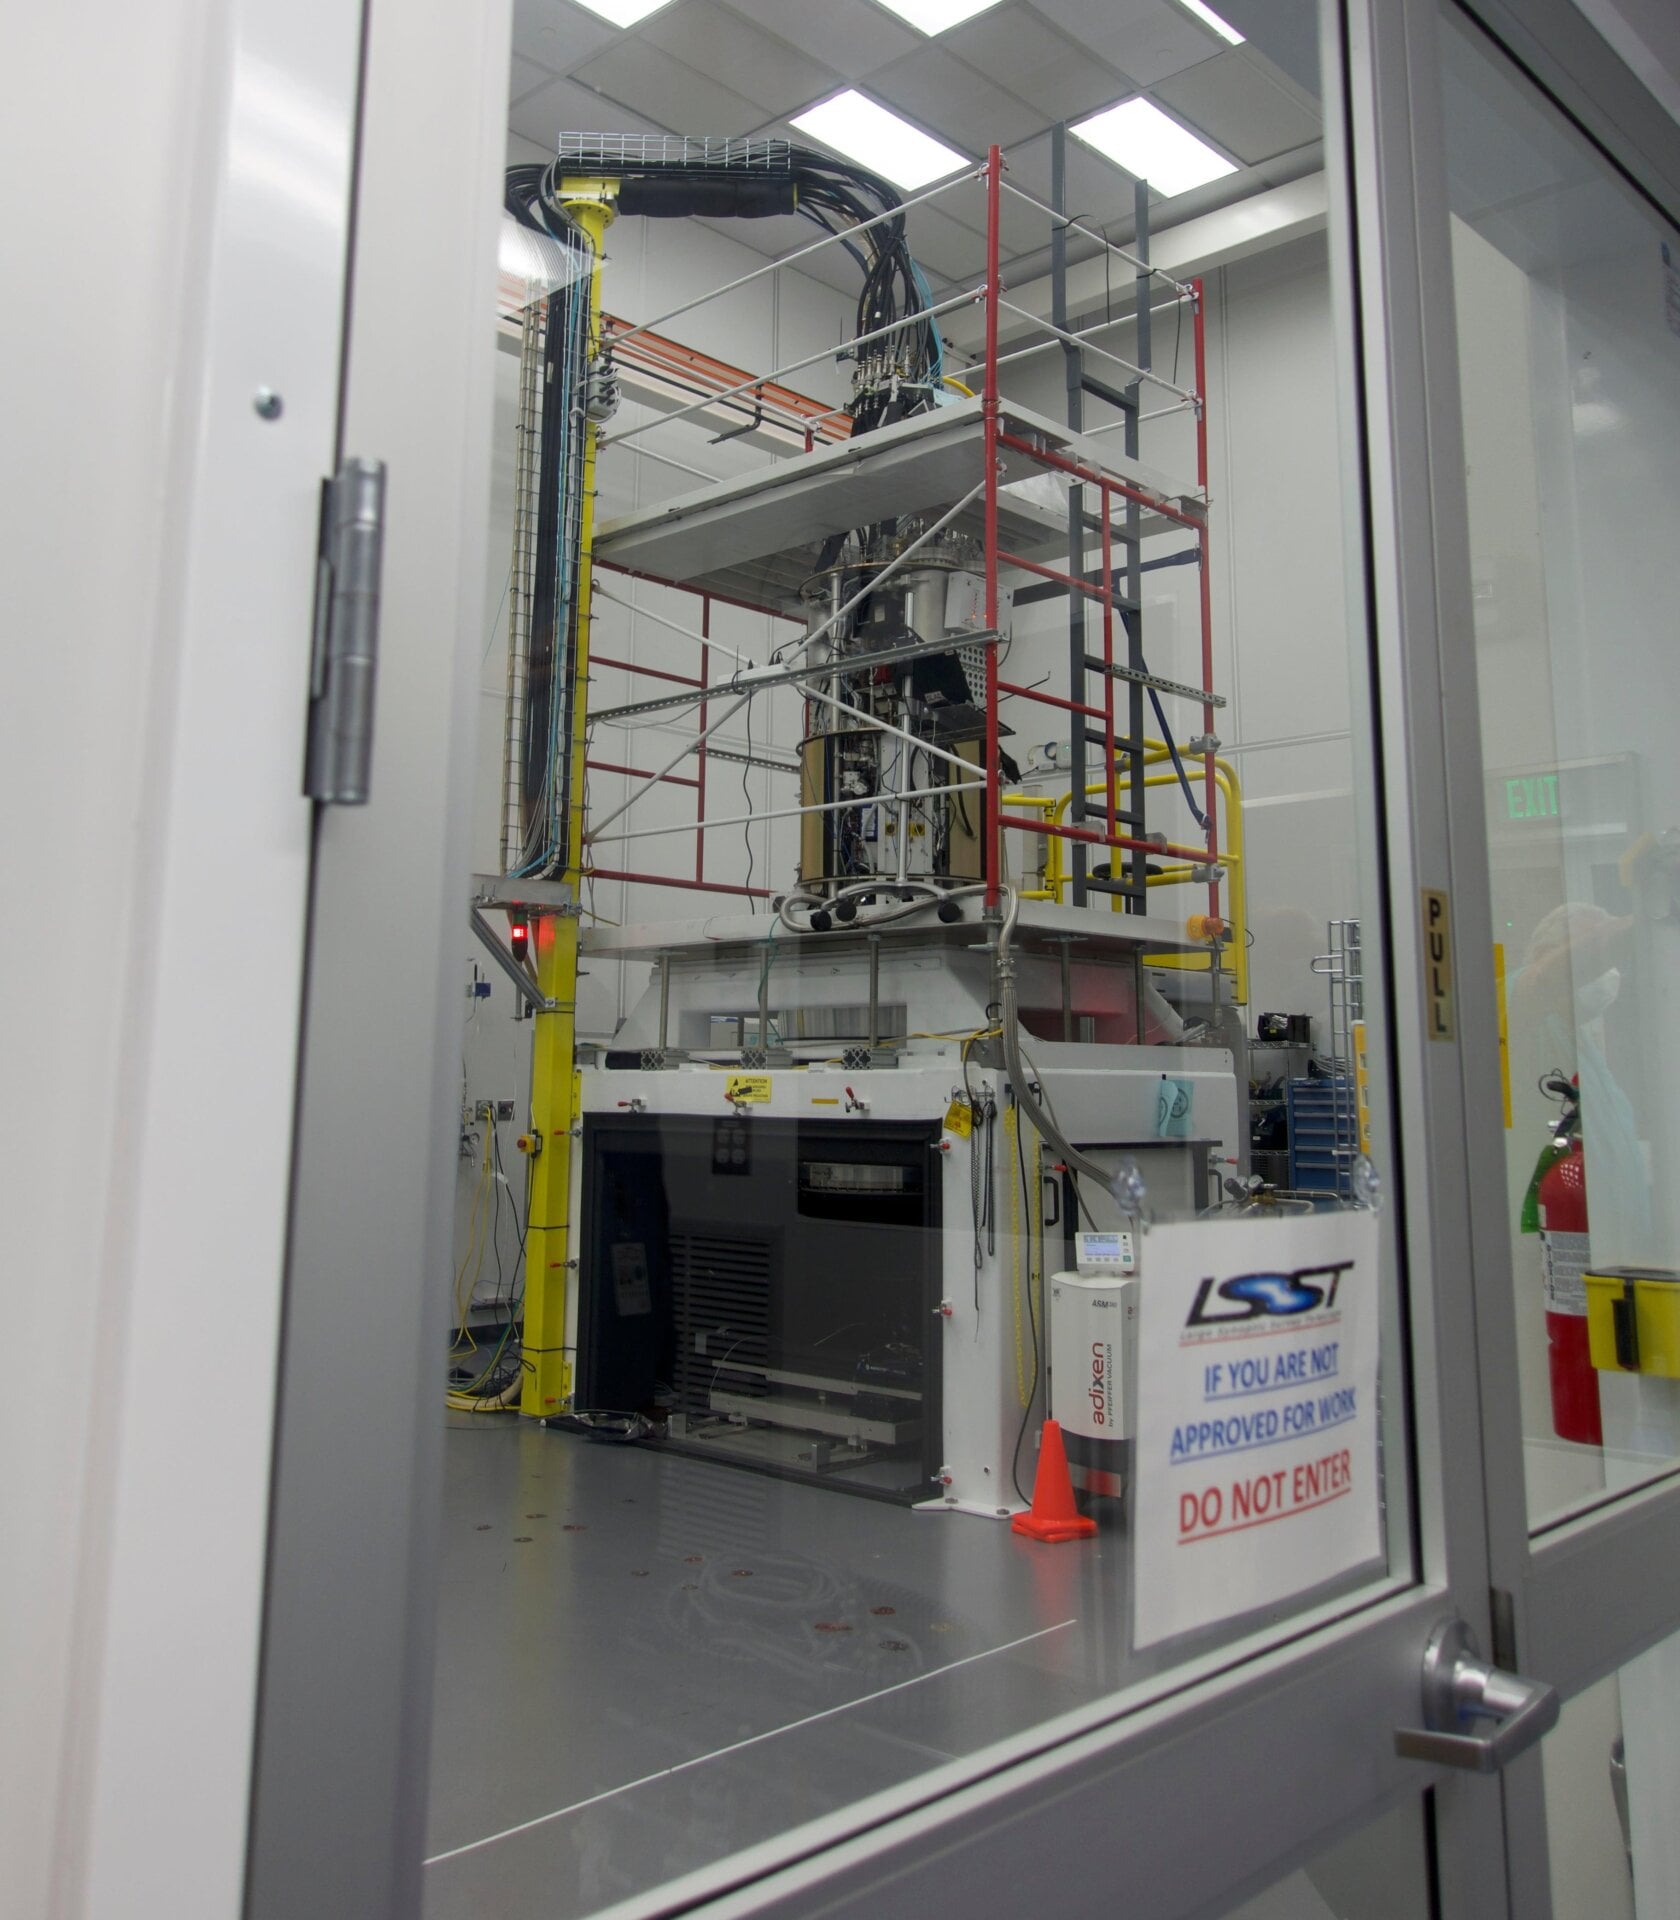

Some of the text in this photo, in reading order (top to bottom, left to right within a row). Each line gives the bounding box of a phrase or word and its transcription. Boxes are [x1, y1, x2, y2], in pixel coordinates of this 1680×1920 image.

[1506, 775, 1558, 818] EXIT
[1427, 897, 1447, 1034] PULL
[1186, 1260, 1355, 1327] LSST
[1089, 1342, 1105, 1425] adixen
[1205, 1342, 1339, 1393] IF YOU ARE NOT
[1171, 1386, 1357, 1457] APPROVED FOR WORK
[1180, 1448, 1352, 1533] DO NOT ENTER
